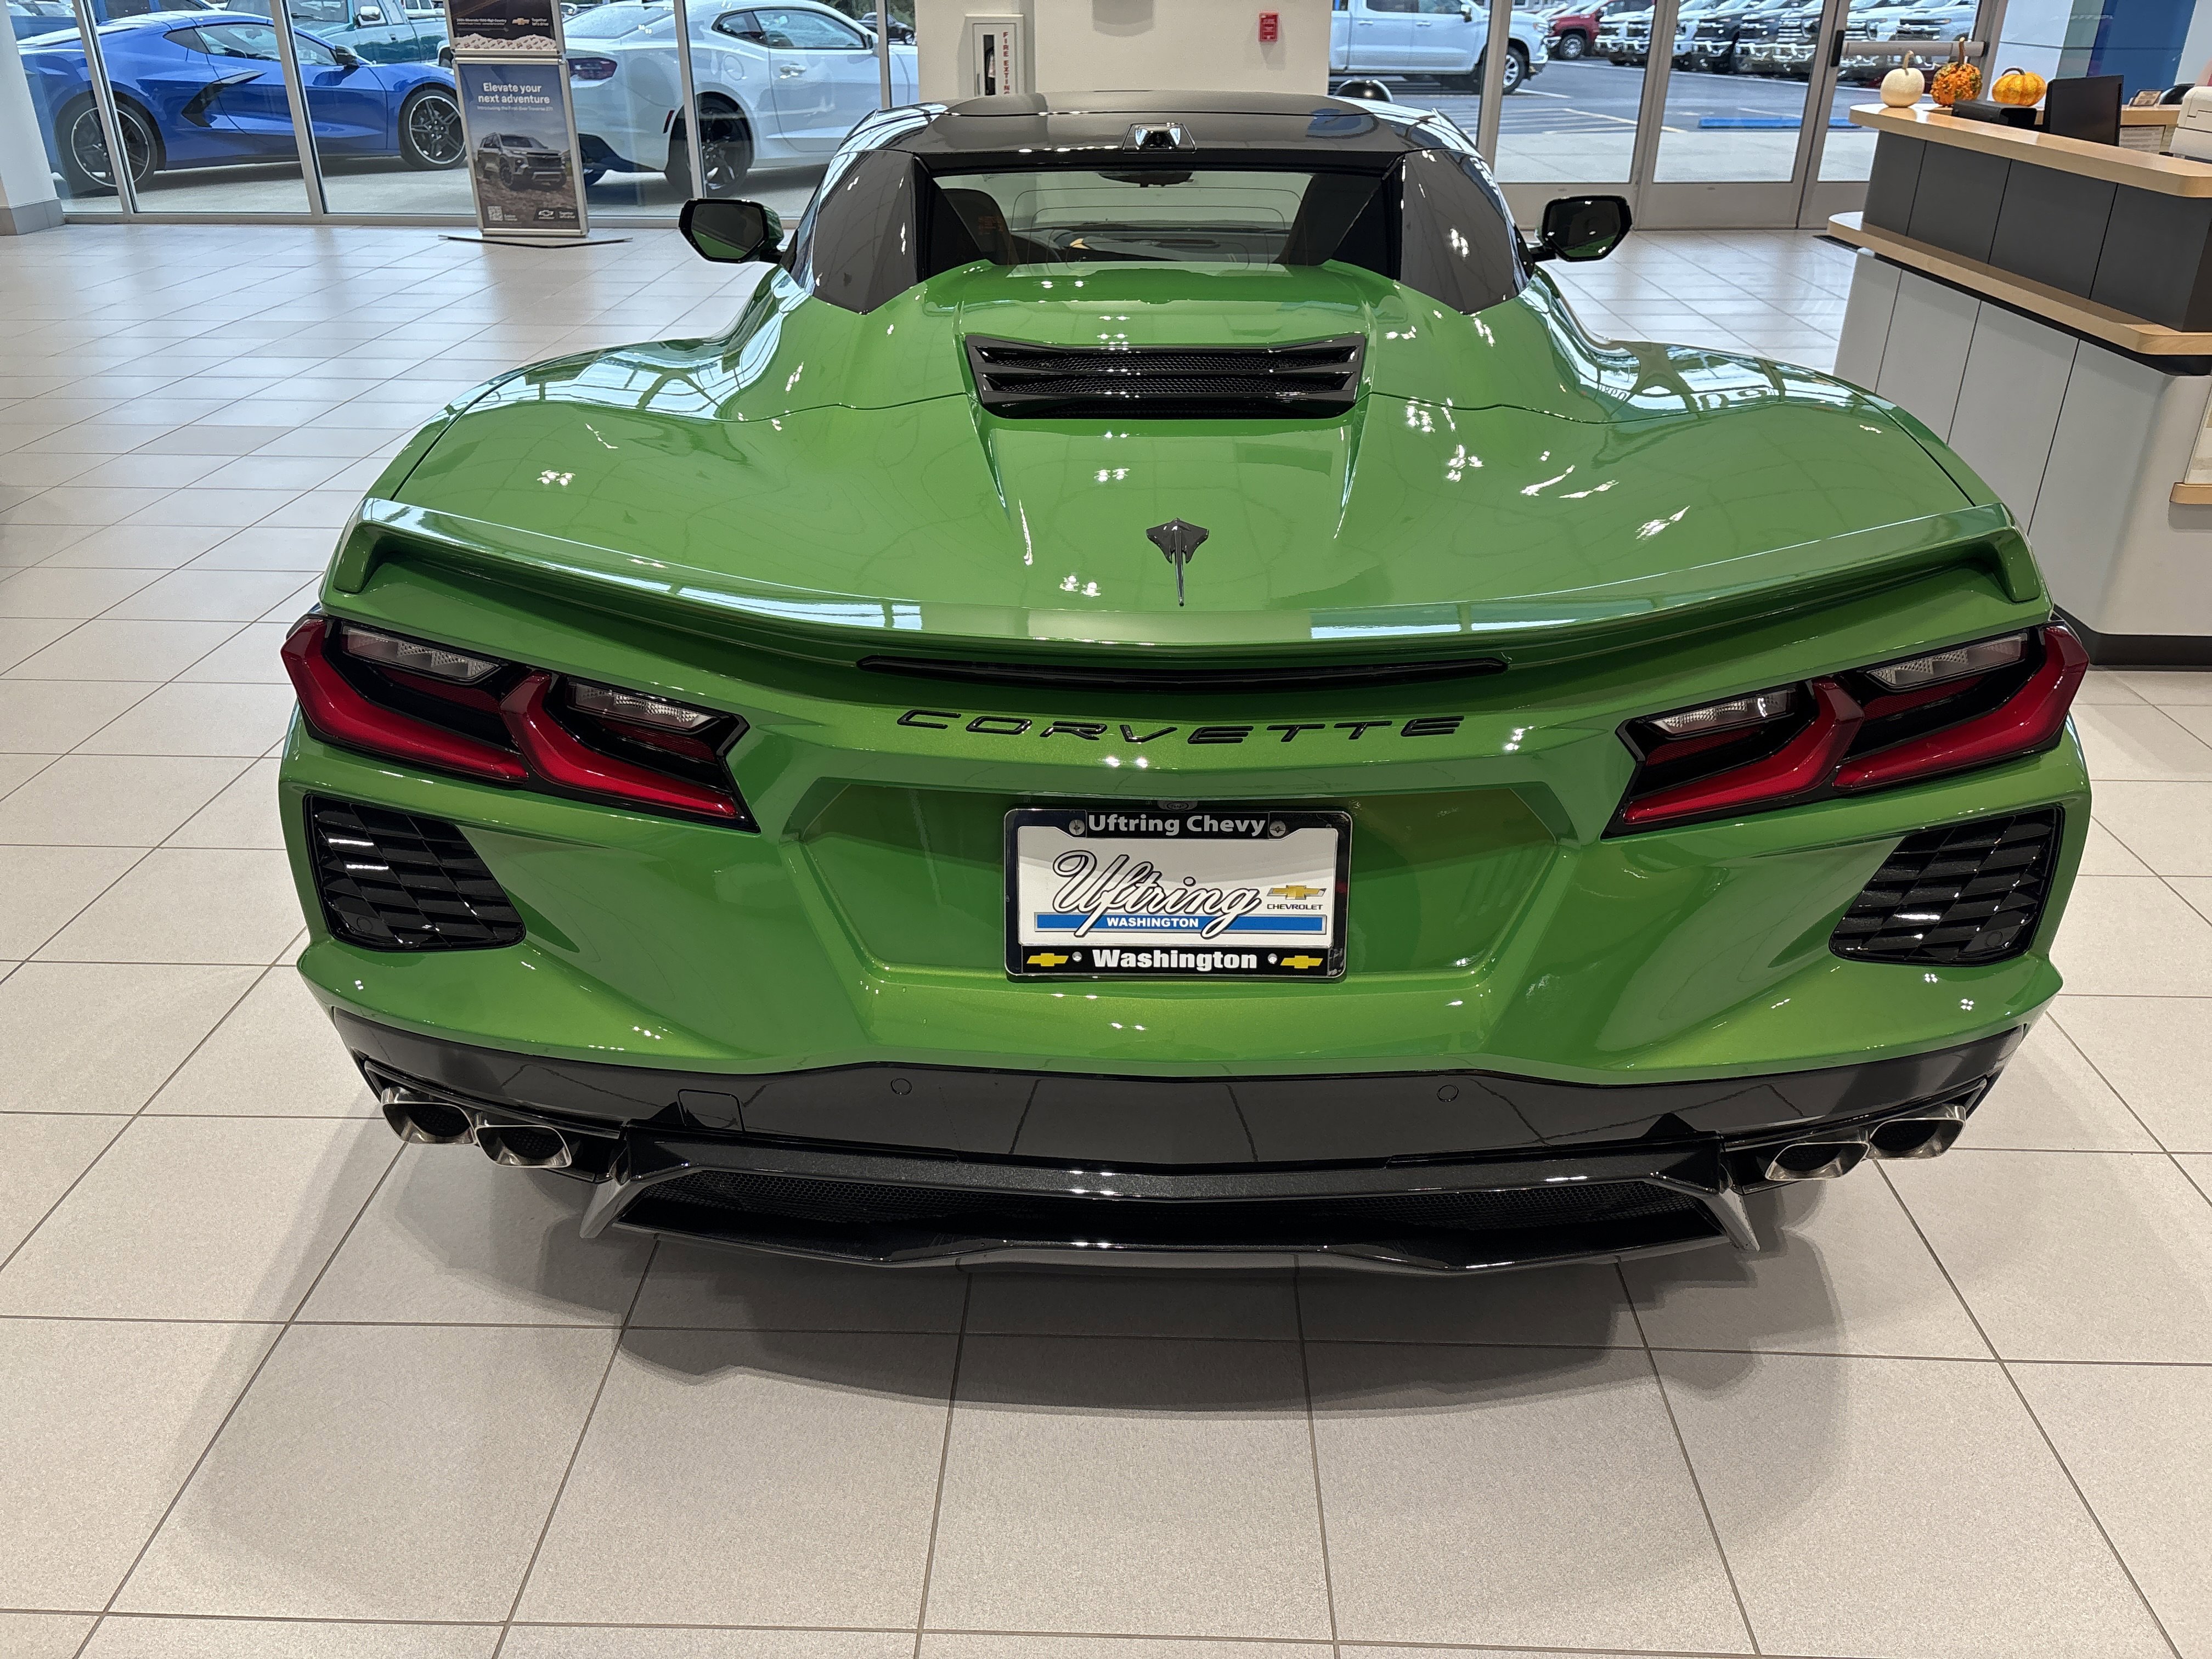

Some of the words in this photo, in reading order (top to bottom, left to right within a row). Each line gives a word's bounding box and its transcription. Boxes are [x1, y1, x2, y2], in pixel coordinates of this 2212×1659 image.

[478, 94, 500, 103] next
[501, 94, 550, 104] adventure
[483, 82, 518, 92] Elevate
[520, 84, 542, 94] your
[896, 708, 1465, 744] CORVETTE
[1088, 814, 1181, 836] Uftring
[1187, 814, 1266, 836] Chevy
[1052, 849, 1262, 939] Uftring
[1106, 917, 1200, 928] WASHINGTON
[1092, 948, 1258, 972] Washington
